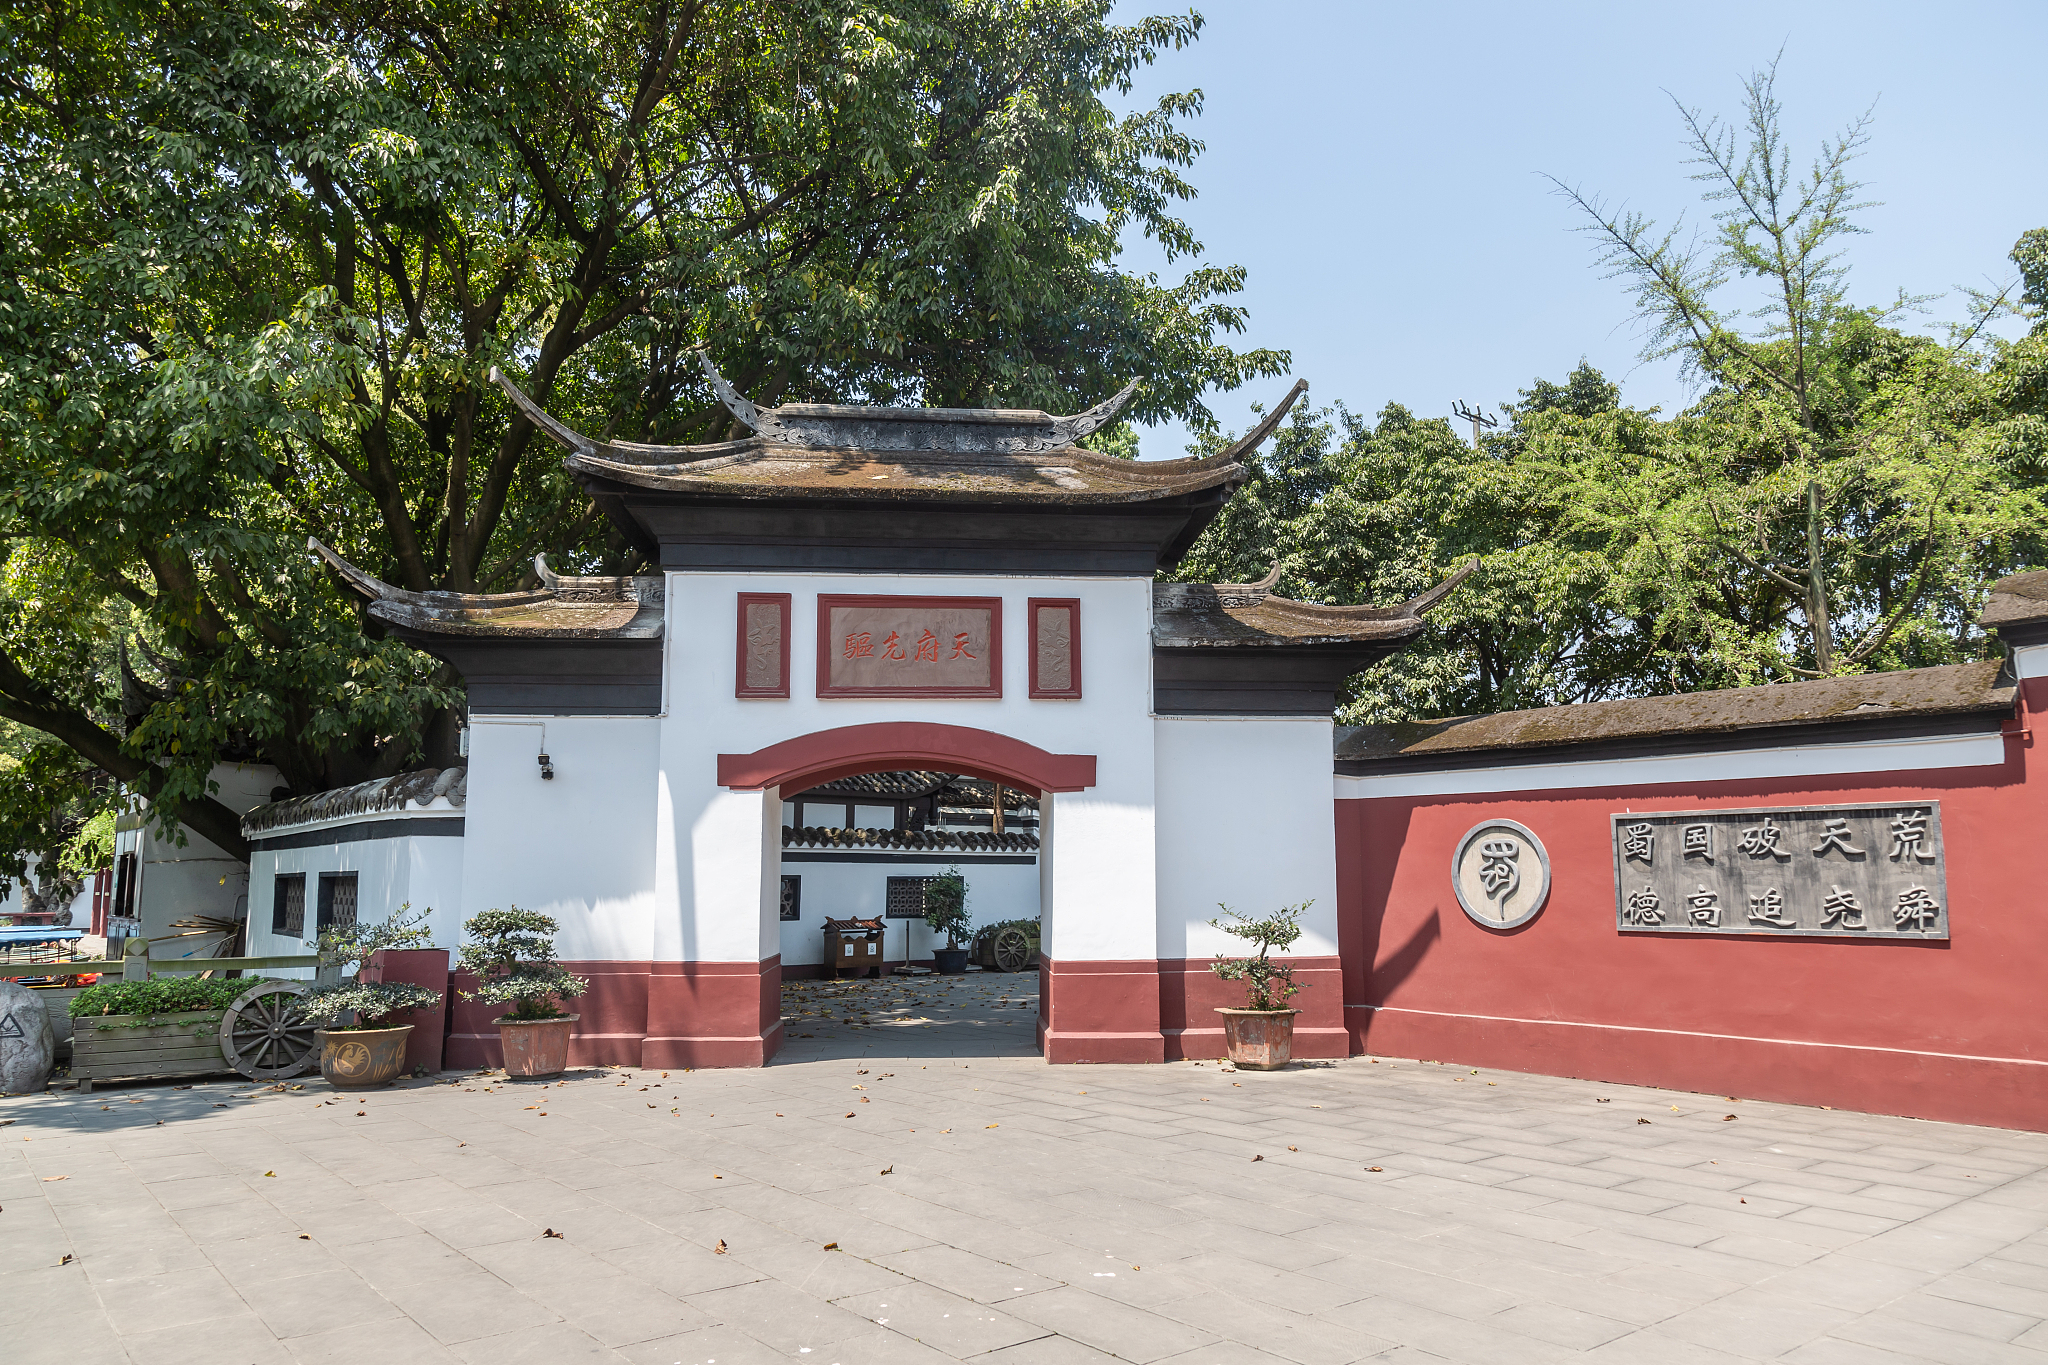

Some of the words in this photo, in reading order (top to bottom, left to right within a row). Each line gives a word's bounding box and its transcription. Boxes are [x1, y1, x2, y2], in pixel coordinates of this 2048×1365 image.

[842, 628, 977, 663] 天府先驅
[1623, 810, 1936, 862] 蜀国破天荒
[1623, 884, 1940, 931] 德高追尧舜
